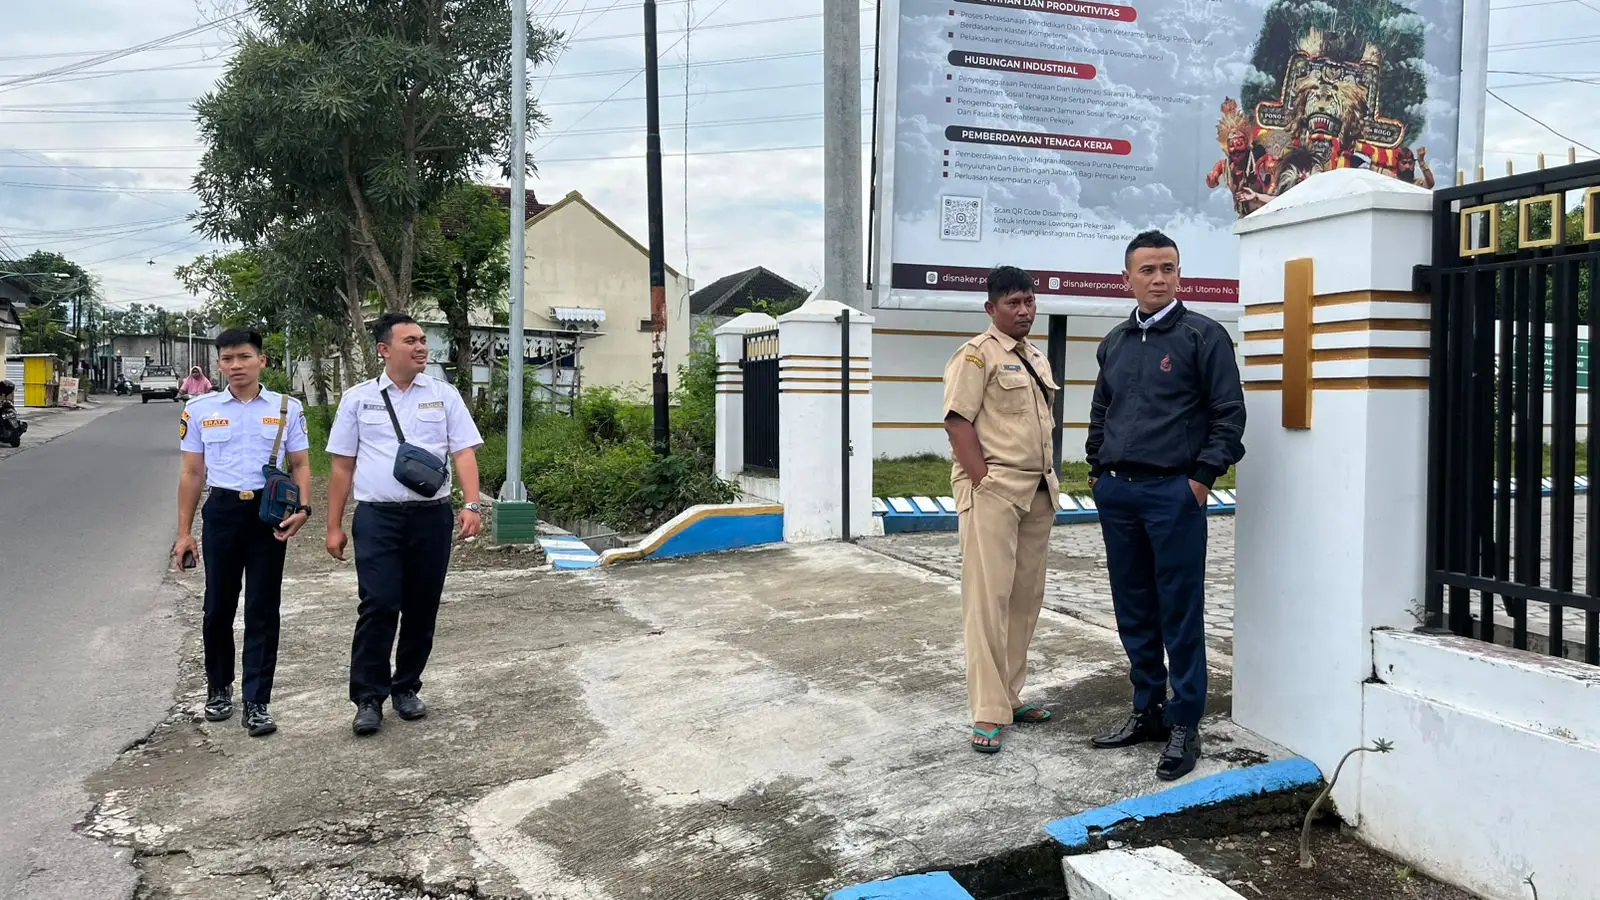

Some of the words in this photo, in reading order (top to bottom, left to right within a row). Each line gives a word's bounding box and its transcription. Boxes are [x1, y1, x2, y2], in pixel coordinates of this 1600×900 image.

[1023, 0, 1044, 8] DAN
[1046, 2, 1120, 17] PRODUKTIVITAS
[984, 14, 1026, 25] Pelaksanaan
[1028, 18, 1066, 30] Pendidikan
[964, 55, 1020, 68] HUBUNGAN
[1023, 62, 1078, 74] INDUSTRIAL
[1024, 92, 1049, 101] Tenaga
[962, 130, 1042, 144] PEMBERDAYAAN
[1044, 137, 1082, 148] TENAGA
[1084, 141, 1113, 150] KERJA
[1008, 154, 1033, 164] Pekerja
[1060, 158, 1091, 167] Indonesia
[954, 172, 987, 181] Perluasan
[989, 175, 1032, 185] Kesempatan
[1042, 210, 1078, 219] Disamping
[1016, 218, 1047, 226] Informasi
[1048, 220, 1082, 229] Lowongan
[1084, 222, 1115, 231] Pekerjaan
[1010, 228, 1041, 236] Kunjungi
[1042, 230, 1075, 238] Instagram
[1097, 233, 1120, 241] Tenaga
